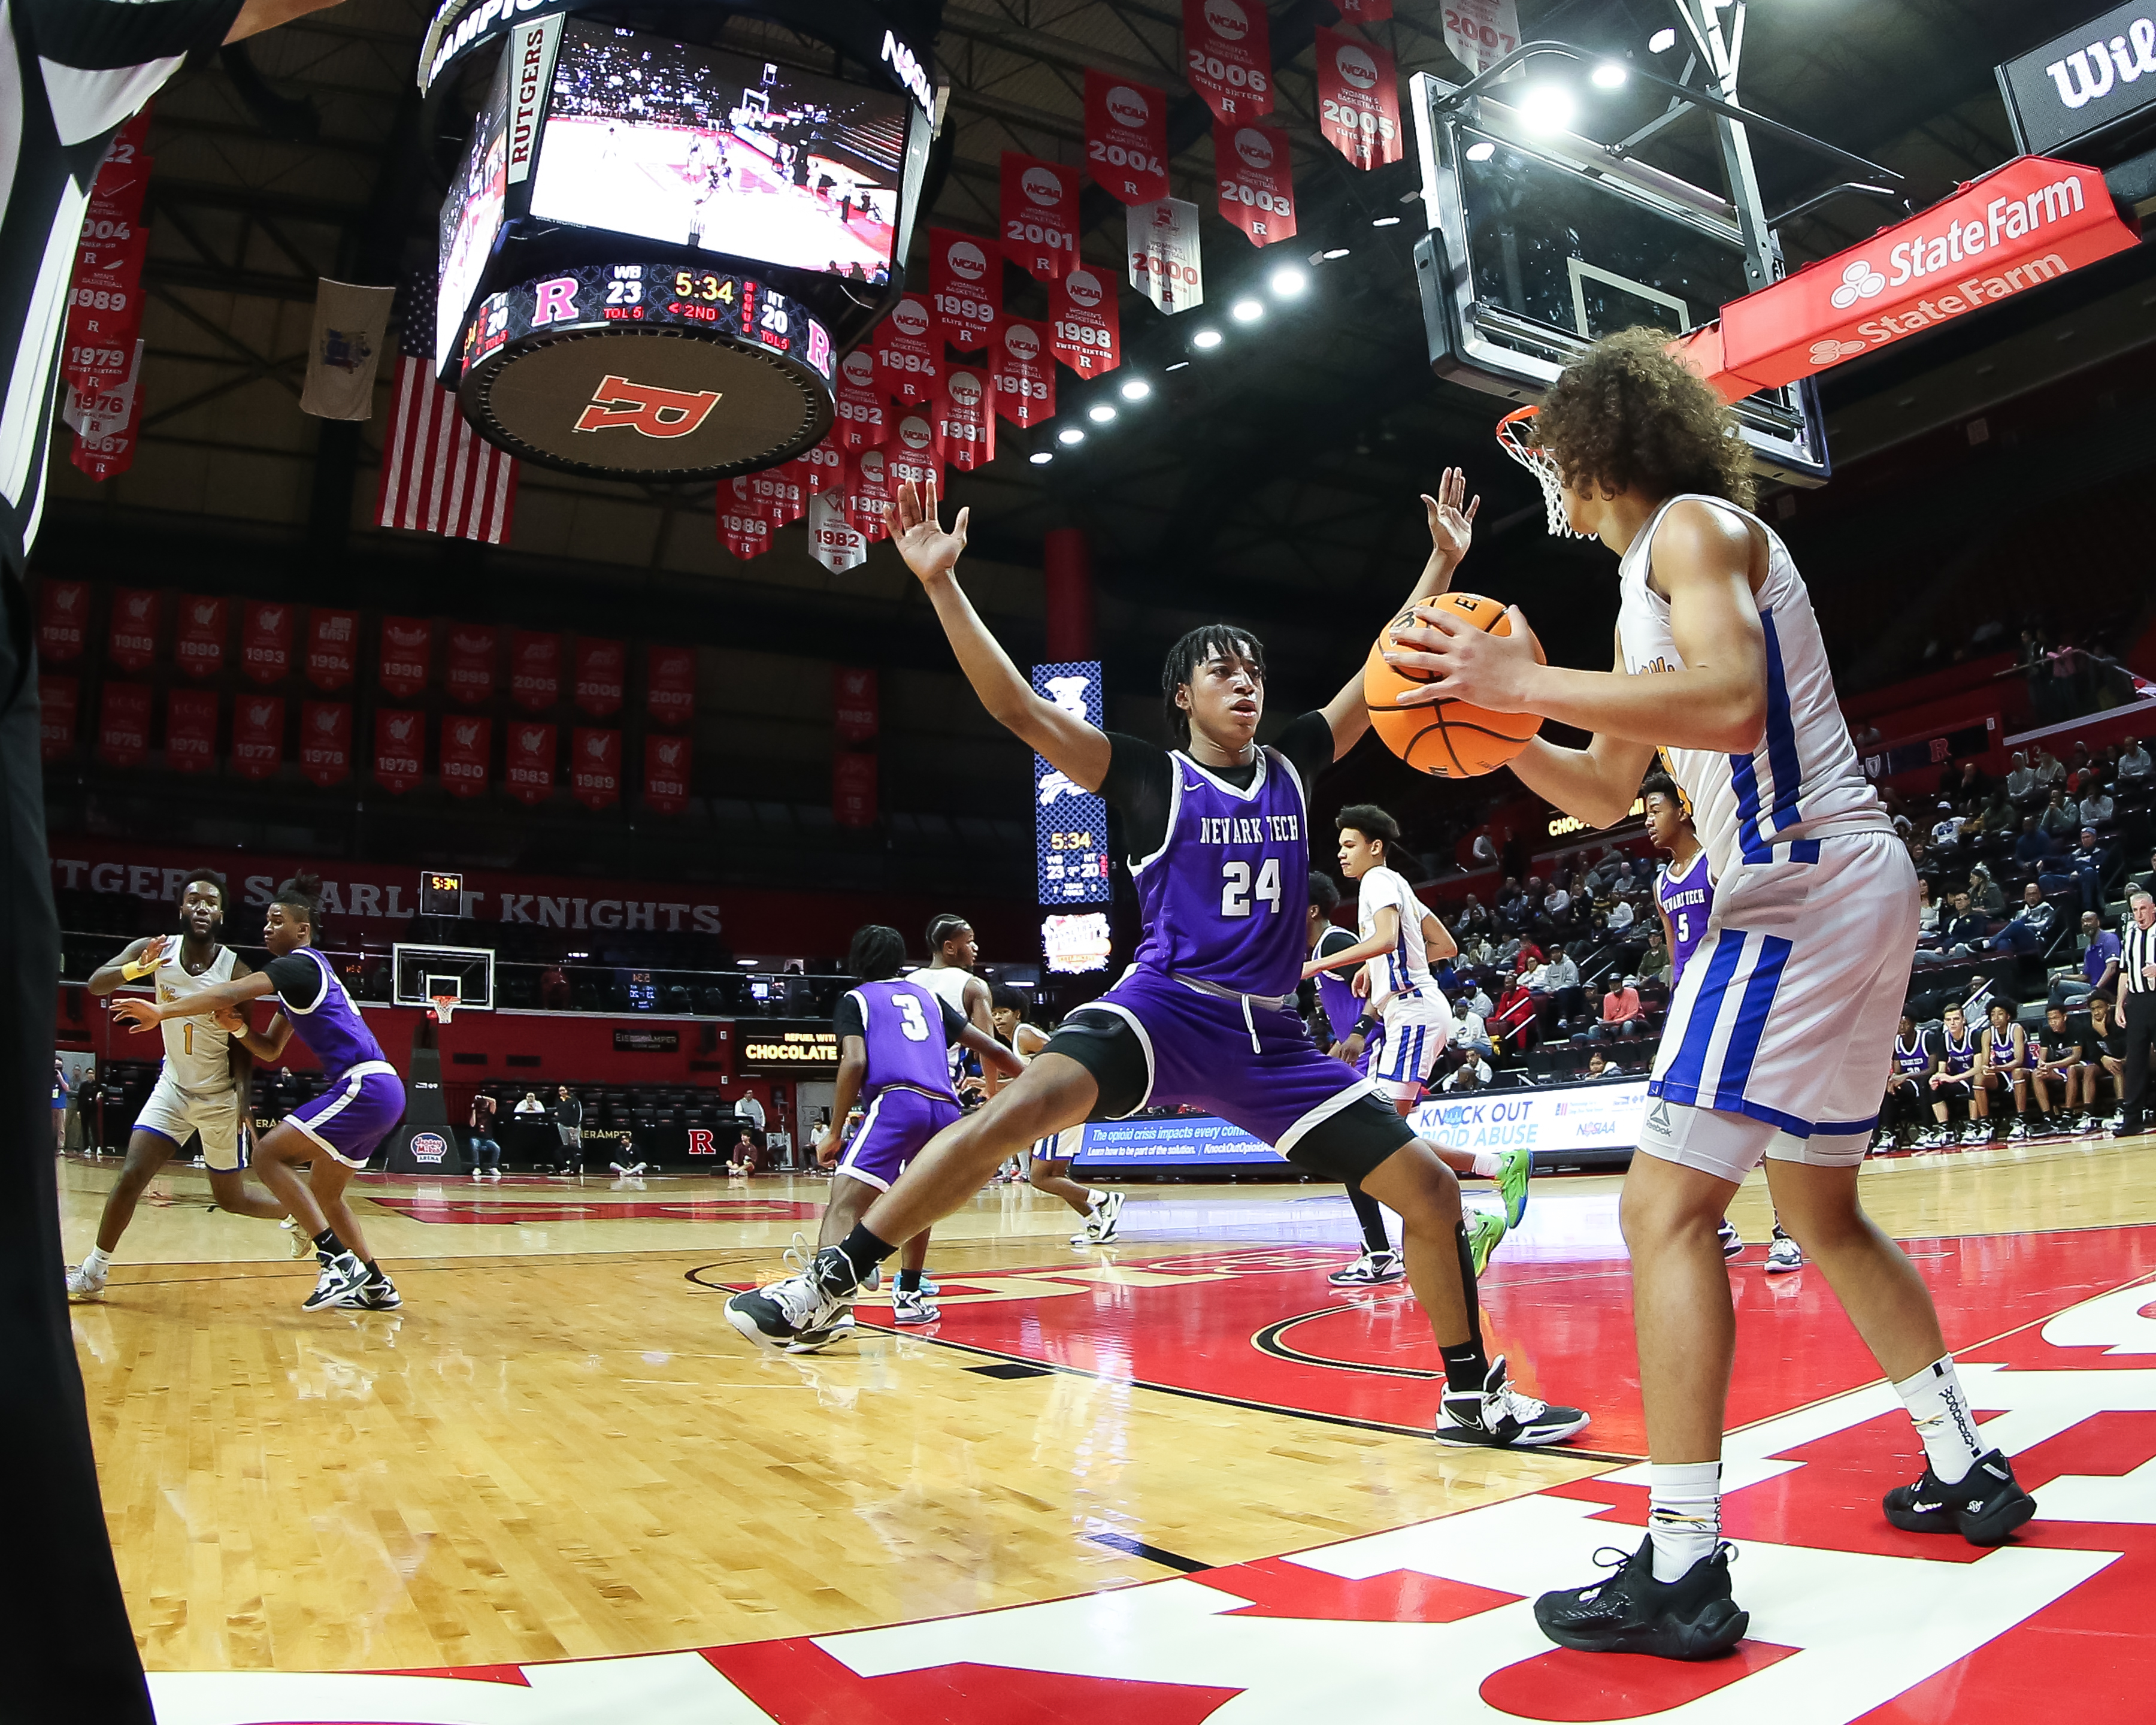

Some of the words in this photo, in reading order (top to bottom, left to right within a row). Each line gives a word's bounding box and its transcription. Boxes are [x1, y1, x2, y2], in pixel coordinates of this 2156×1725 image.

[1446, 10, 1515, 54] 2007
[1189, 49, 1267, 91] 2006
[512, 28, 544, 165] RUTGERS
[1222, 96, 1236, 113] R
[1322, 99, 1395, 139] 2005
[1089, 140, 1165, 177] 2004
[1124, 181, 1138, 195] R
[1221, 180, 1291, 217] 2003
[1007, 220, 1073, 251] 2001
[1252, 220, 1267, 235] R
[84, 252, 96, 264] R
[952, 256, 986, 271] NCAA
[1037, 258, 1050, 270] R
[614, 265, 641, 279] WB
[1132, 253, 1198, 285] 2000
[606, 281, 641, 304] 23
[675, 272, 734, 304] 5:34
[1069, 286, 1101, 299] NCAA
[68, 288, 126, 311] 1989
[530, 277, 580, 328] R
[767, 290, 785, 308] NT
[934, 293, 994, 322] 1999
[486, 306, 508, 337] 20
[604, 308, 628, 319] TOL
[632, 307, 643, 318] 5
[684, 305, 717, 321] 2ND
[761, 304, 788, 334] 20
[87, 320, 99, 332] R
[960, 330, 972, 342] R
[1055, 320, 1112, 349] 1998
[1008, 339, 1039, 352] NCAA
[71, 346, 125, 367] 1979
[879, 349, 935, 376] 1994
[1080, 355, 1092, 368] R
[903, 384, 915, 395] R
[994, 374, 1047, 400] 1993
[572, 374, 723, 439] R
[1018, 407, 1028, 418] R
[850, 433, 862, 444] R
[940, 420, 986, 443] 1991
[959, 451, 971, 462] R
[810, 474, 819, 486] R
[889, 462, 938, 483] 1989
[752, 479, 800, 501] 1988
[720, 515, 767, 535] 1986
[869, 523, 879, 534] R
[815, 529, 860, 549] 1982
[1929, 738, 1952, 762] R
[1200, 816, 1264, 844] NEWARK
[1265, 815, 1299, 842] TECH
[1051, 831, 1091, 850] 5:34
[1046, 854, 1064, 865] WB
[1083, 853, 1097, 862] NT
[1046, 865, 1065, 880] 23
[1080, 863, 1100, 878] 20
[432, 877, 458, 891] 5:34
[1221, 858, 1282, 916] 24
[1685, 888, 1705, 907] TECH
[499, 893, 722, 934] KNIGHTS
[1677, 913, 1689, 942] 5
[892, 993, 931, 1042] 3
[183, 1023, 194, 1055] 1
[785, 1033, 815, 1042] REFUEL
[746, 1044, 838, 1060] CHOCOLATE
[1491, 1101, 1533, 1124] OUT
[256, 1118, 280, 1128] ERA
[689, 1129, 716, 1155] R
[1107, 1126, 1135, 1143] opioid
[1157, 1125, 1193, 1141] impacts
[1194, 1126, 1220, 1140] every
[1474, 1123, 1539, 1146] ABUSE
